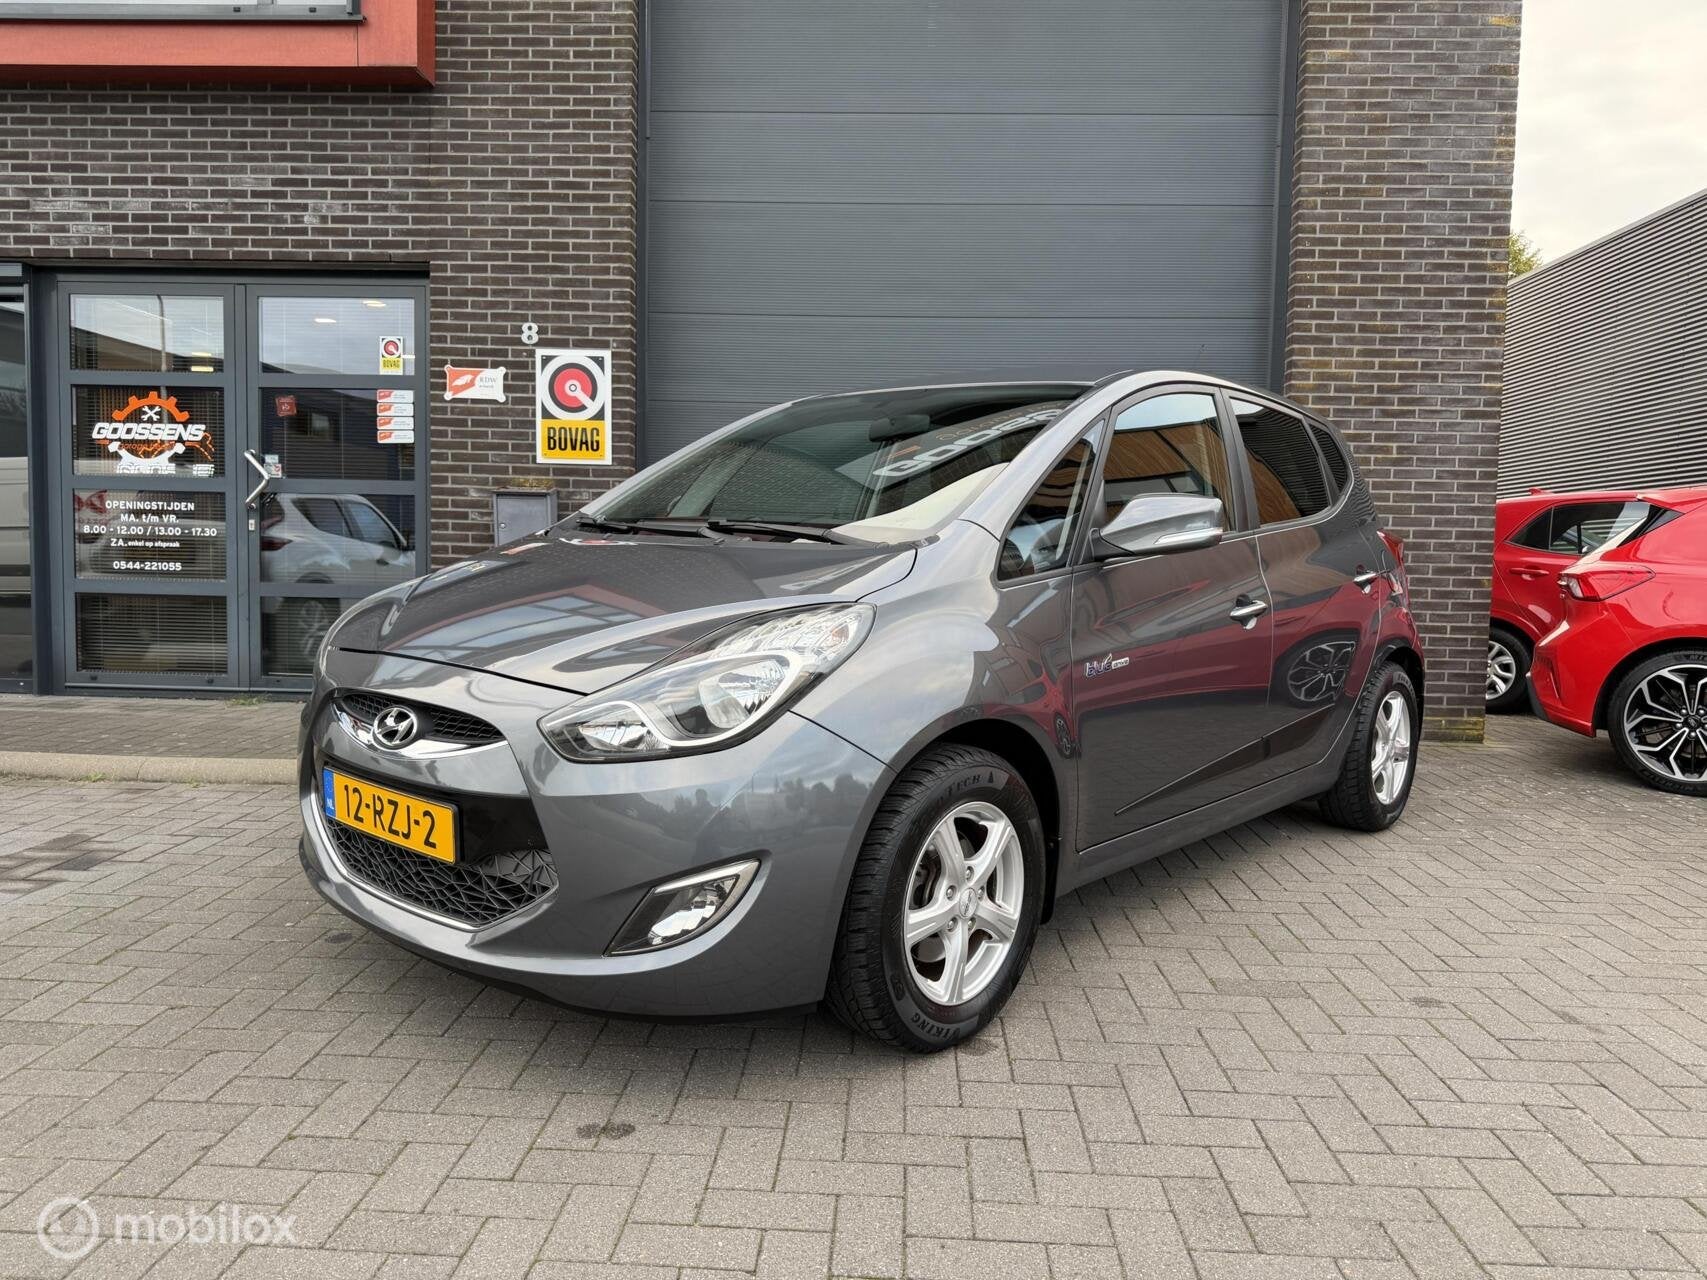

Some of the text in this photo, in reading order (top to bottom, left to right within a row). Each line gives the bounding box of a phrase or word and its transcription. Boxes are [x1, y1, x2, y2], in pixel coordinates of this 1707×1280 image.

[521, 322, 539, 345] 8
[383, 360, 400, 368] BOVAG
[92, 422, 206, 441] GOOSSENS
[547, 426, 600, 452] BOVAG
[105, 500, 195, 511] OPENINGSTIJDEN
[120, 514, 179, 524] MA. t/m VR.
[83, 525, 107, 534] 8.00
[116, 526, 144, 535] 12.00
[154, 526, 181, 536] 13.00
[191, 528, 217, 536] 17.30
[110, 538, 127, 547] ZA.
[113, 561, 182, 571] 0544-221055
[344, 784, 437, 849] 12-RZJ-2
